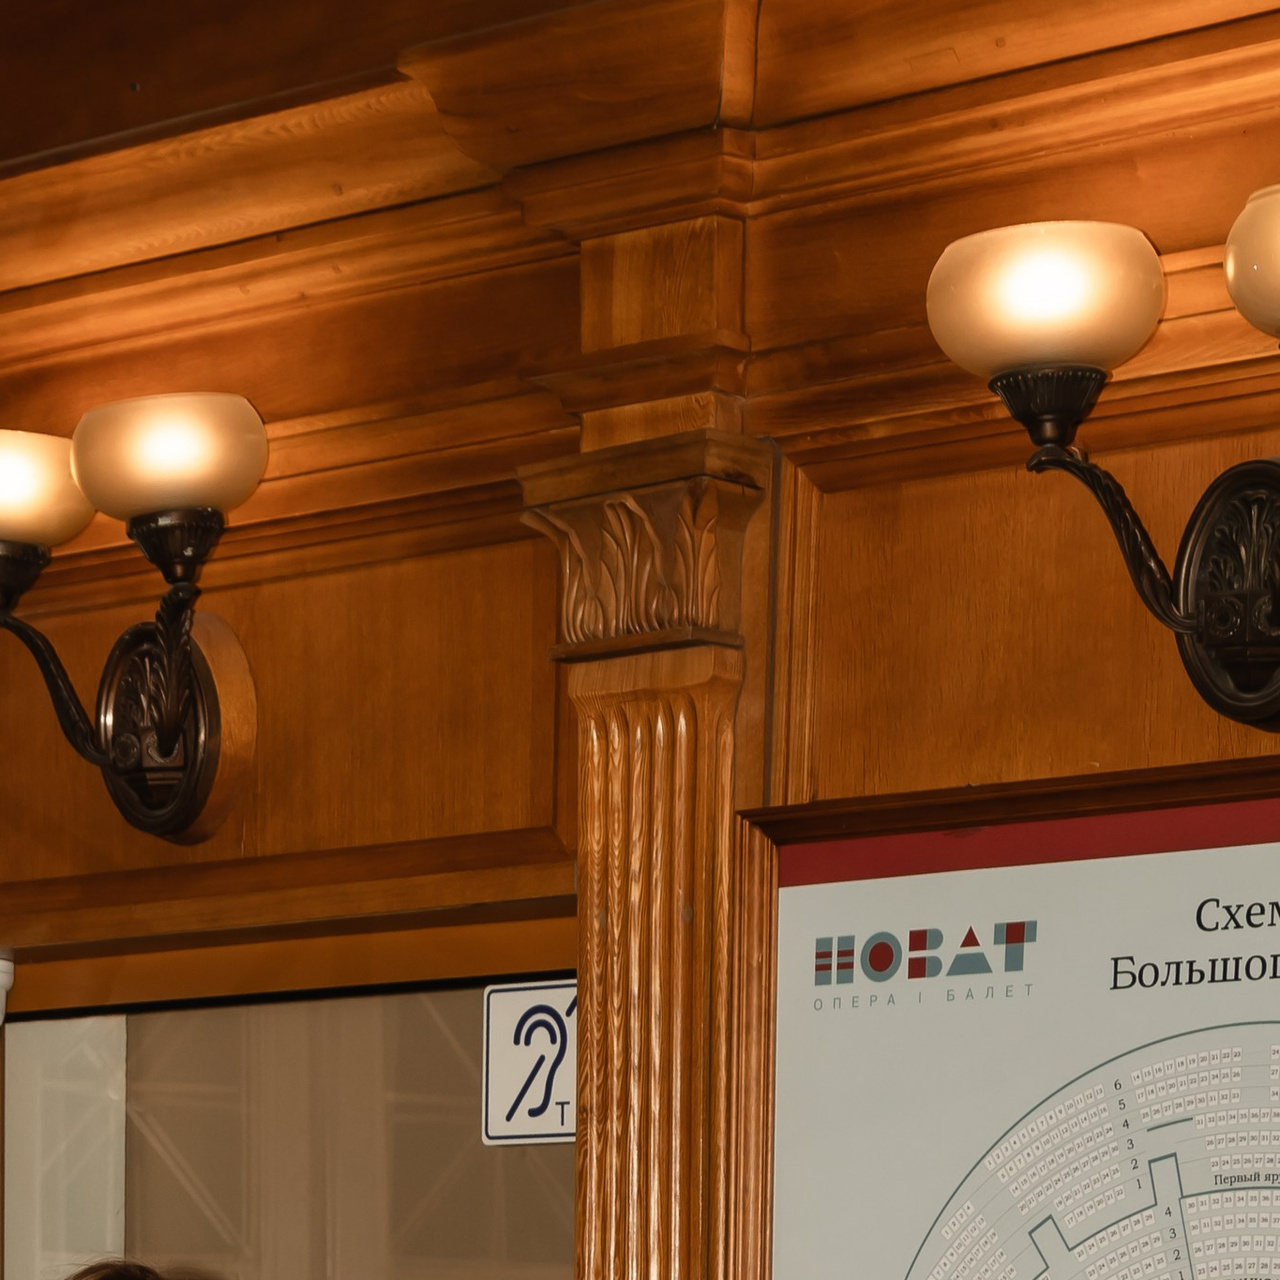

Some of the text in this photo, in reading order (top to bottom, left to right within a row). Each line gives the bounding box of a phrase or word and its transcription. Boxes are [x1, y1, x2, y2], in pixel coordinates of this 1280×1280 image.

[815, 920, 1037, 986] НОВАТ
[813, 993, 895, 1011] ОПЕРА
[946, 984, 1033, 1002] БАЛЕТ
[1114, 1079, 1121, 1090] 6
[1119, 1099, 1125, 1110] 5
[1123, 1119, 1129, 1129] 4
[1127, 1139, 1134, 1150] 3
[1131, 1158, 1138, 1170] 2
[1137, 1179, 1141, 1189] 1
[1214, 1172, 1261, 1186] Первый
[1165, 1207, 1172, 1217] 4
[1169, 1228, 1176, 1239] 3
[1173, 1249, 1180, 1260] 2
